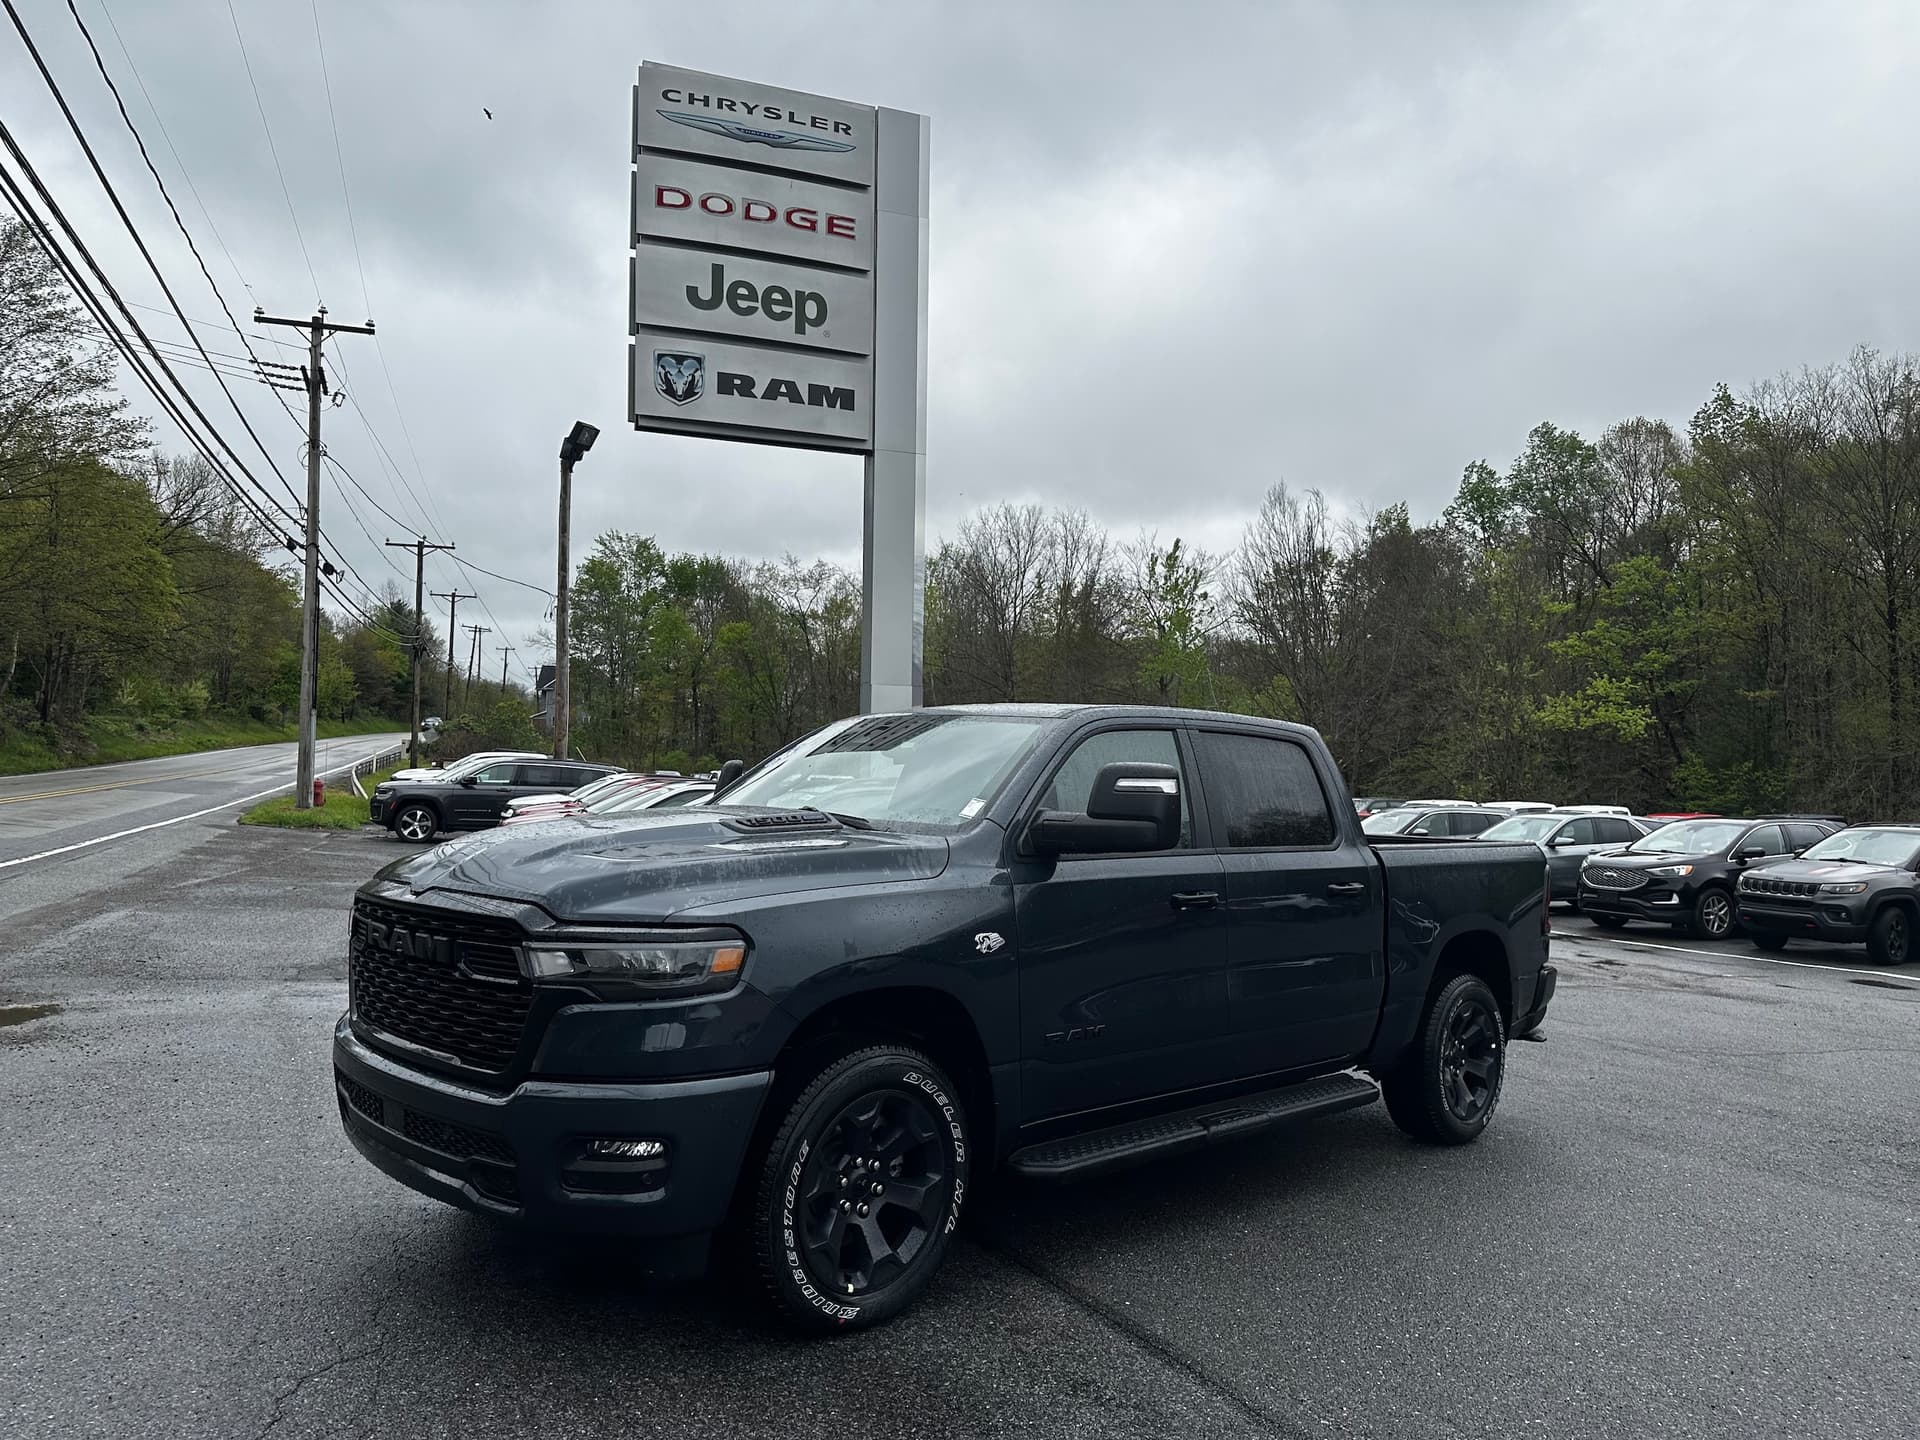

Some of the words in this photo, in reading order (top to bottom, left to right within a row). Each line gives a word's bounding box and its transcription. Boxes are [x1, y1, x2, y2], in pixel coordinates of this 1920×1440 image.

[661, 88, 853, 136] CHRYSLER
[654, 184, 857, 240] DODGE
[685, 263, 828, 335] Jeep
[716, 371, 856, 411] RAM
[366, 920, 450, 962] RAM
[903, 1071, 965, 1162] DUELER
[783, 1139, 861, 1320] BRIDGESTONE
